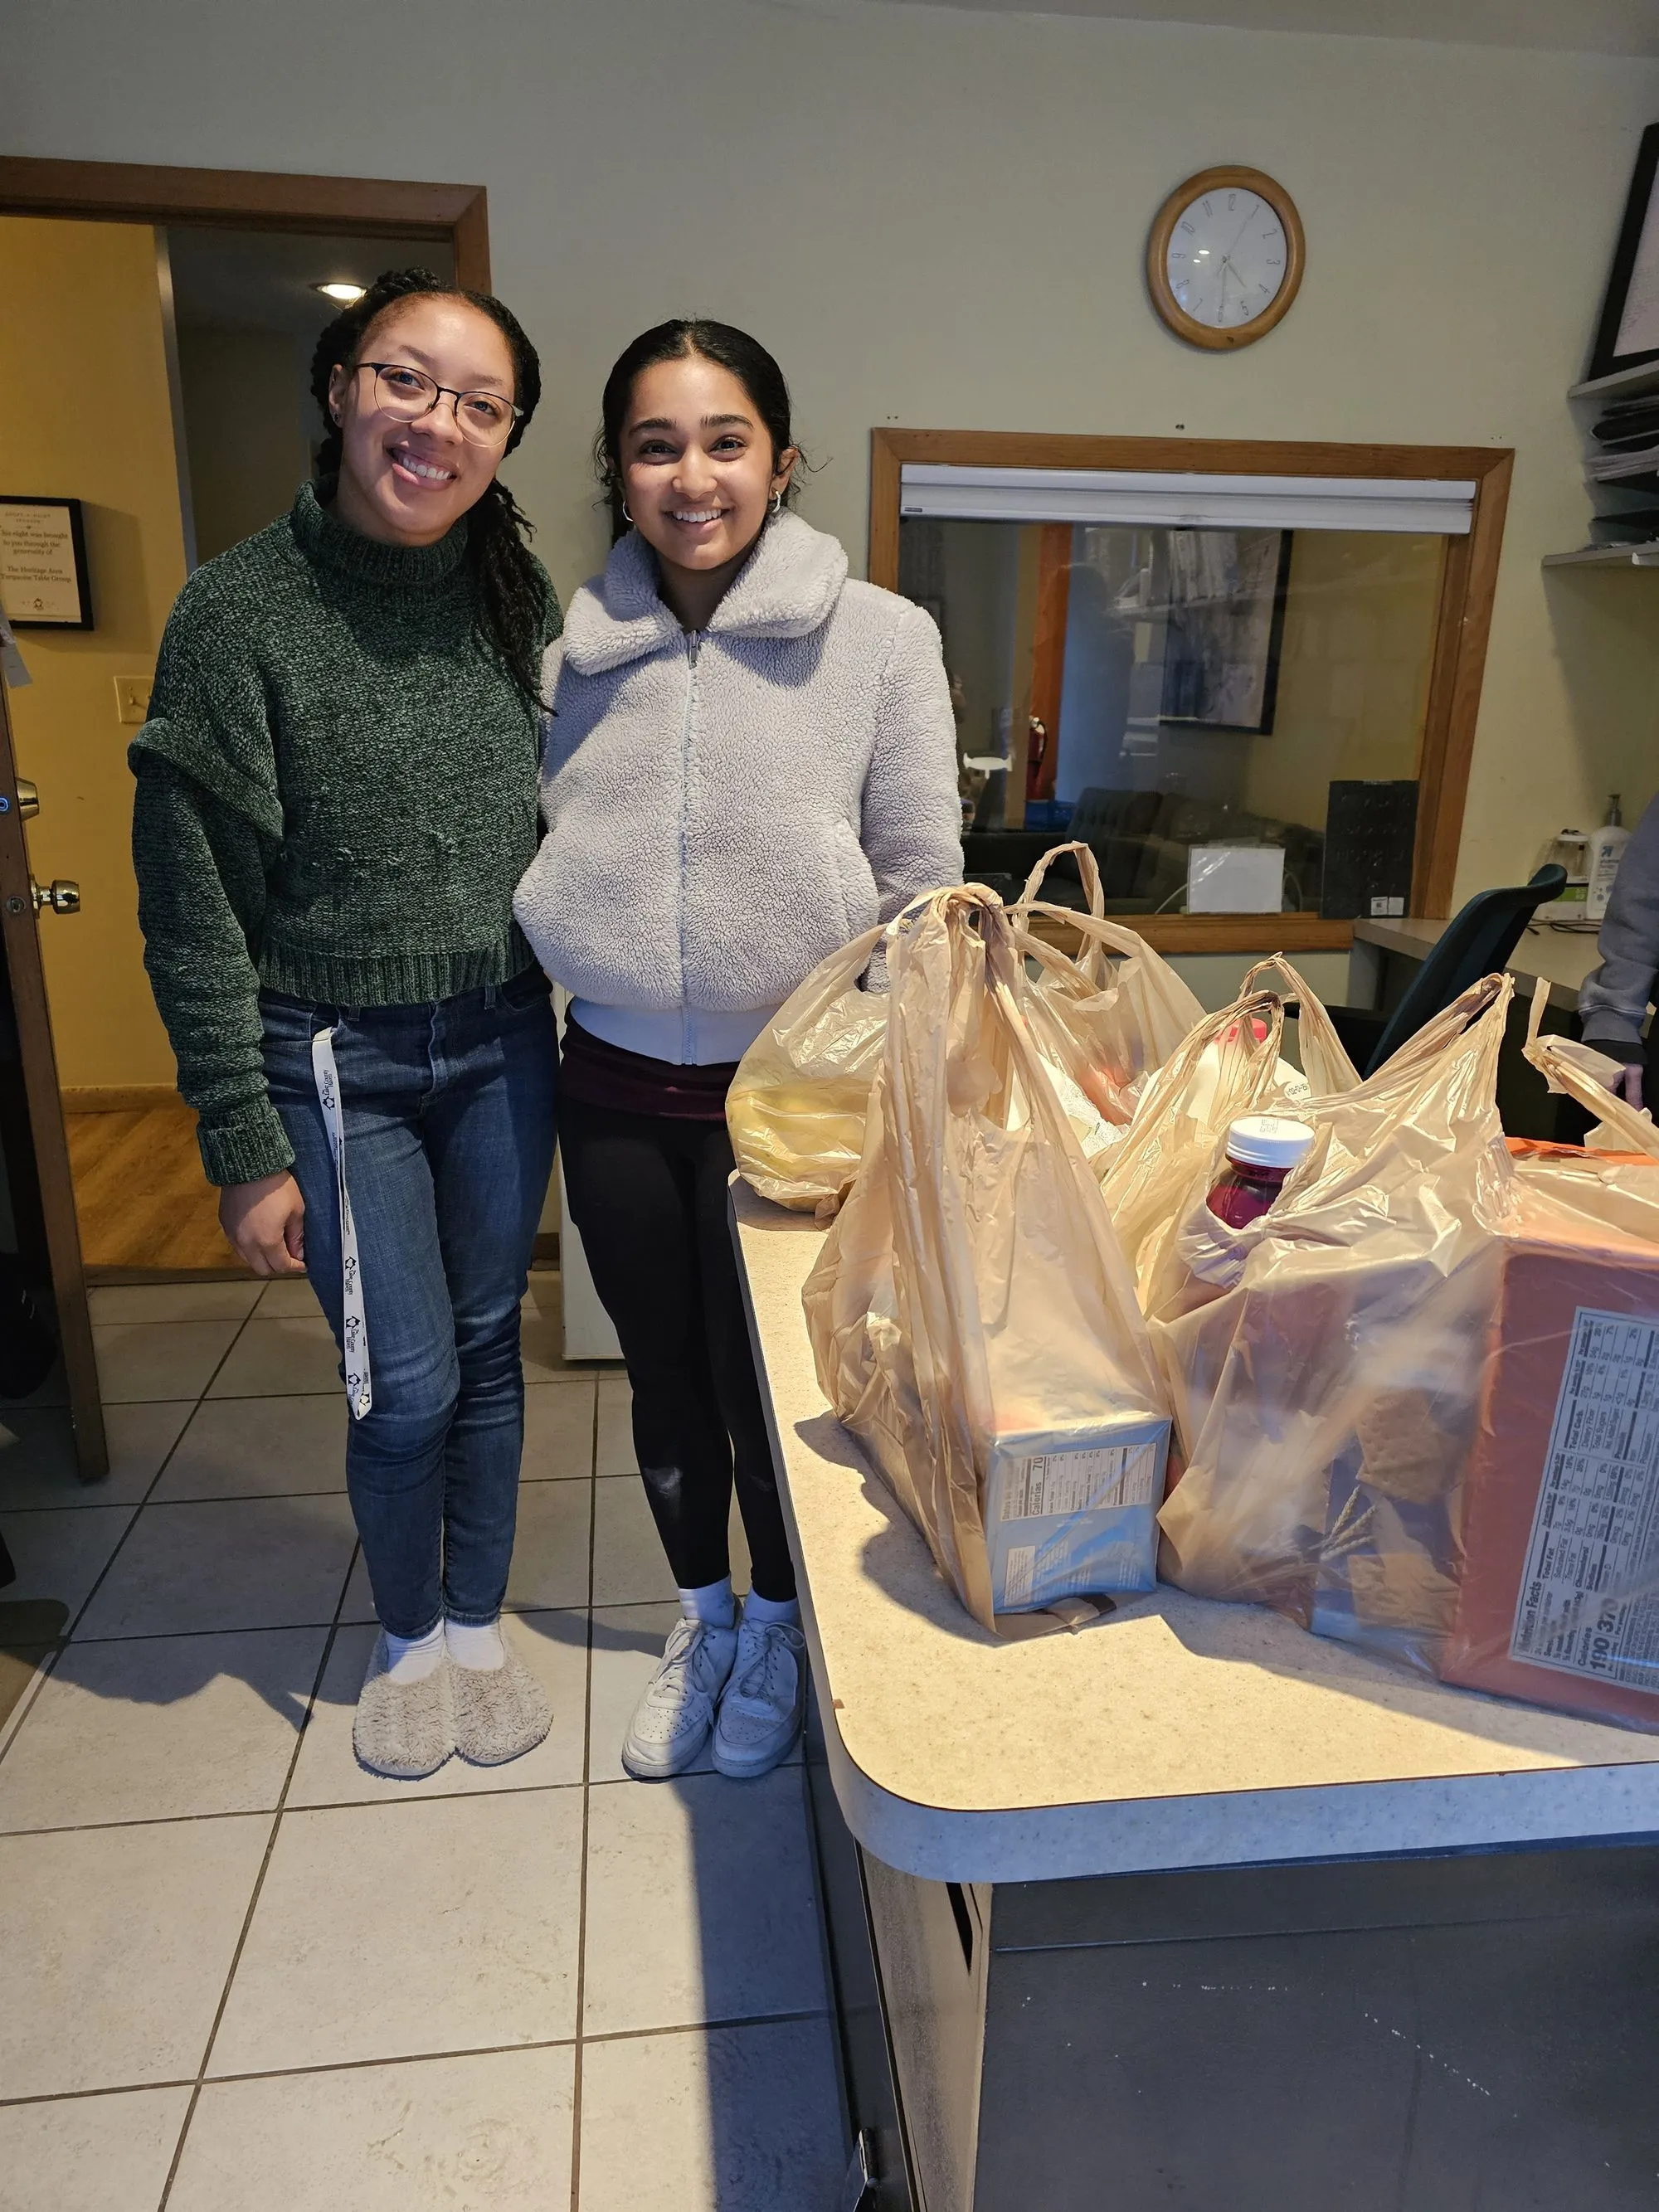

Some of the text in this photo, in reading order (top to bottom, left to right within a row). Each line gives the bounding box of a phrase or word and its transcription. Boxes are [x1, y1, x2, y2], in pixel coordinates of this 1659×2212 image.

[1228, 193, 1236, 211] 12
[1180, 220, 1195, 236] 10
[1262, 228, 1278, 240] 2
[1175, 279, 1190, 290] 8
[1258, 283, 1270, 294] 4
[1240, 300, 1249, 316] 5
[1569, 1429, 1579, 1449] Total
[1033, 1457, 1044, 1471] 70
[1541, 1547, 1554, 1580] Total Fat
[1525, 1580, 1542, 1607] Facts
[1596, 1597, 1619, 1633] 370
[1577, 1626, 1593, 1665] Calories
[1588, 1636, 1611, 1670] 190
